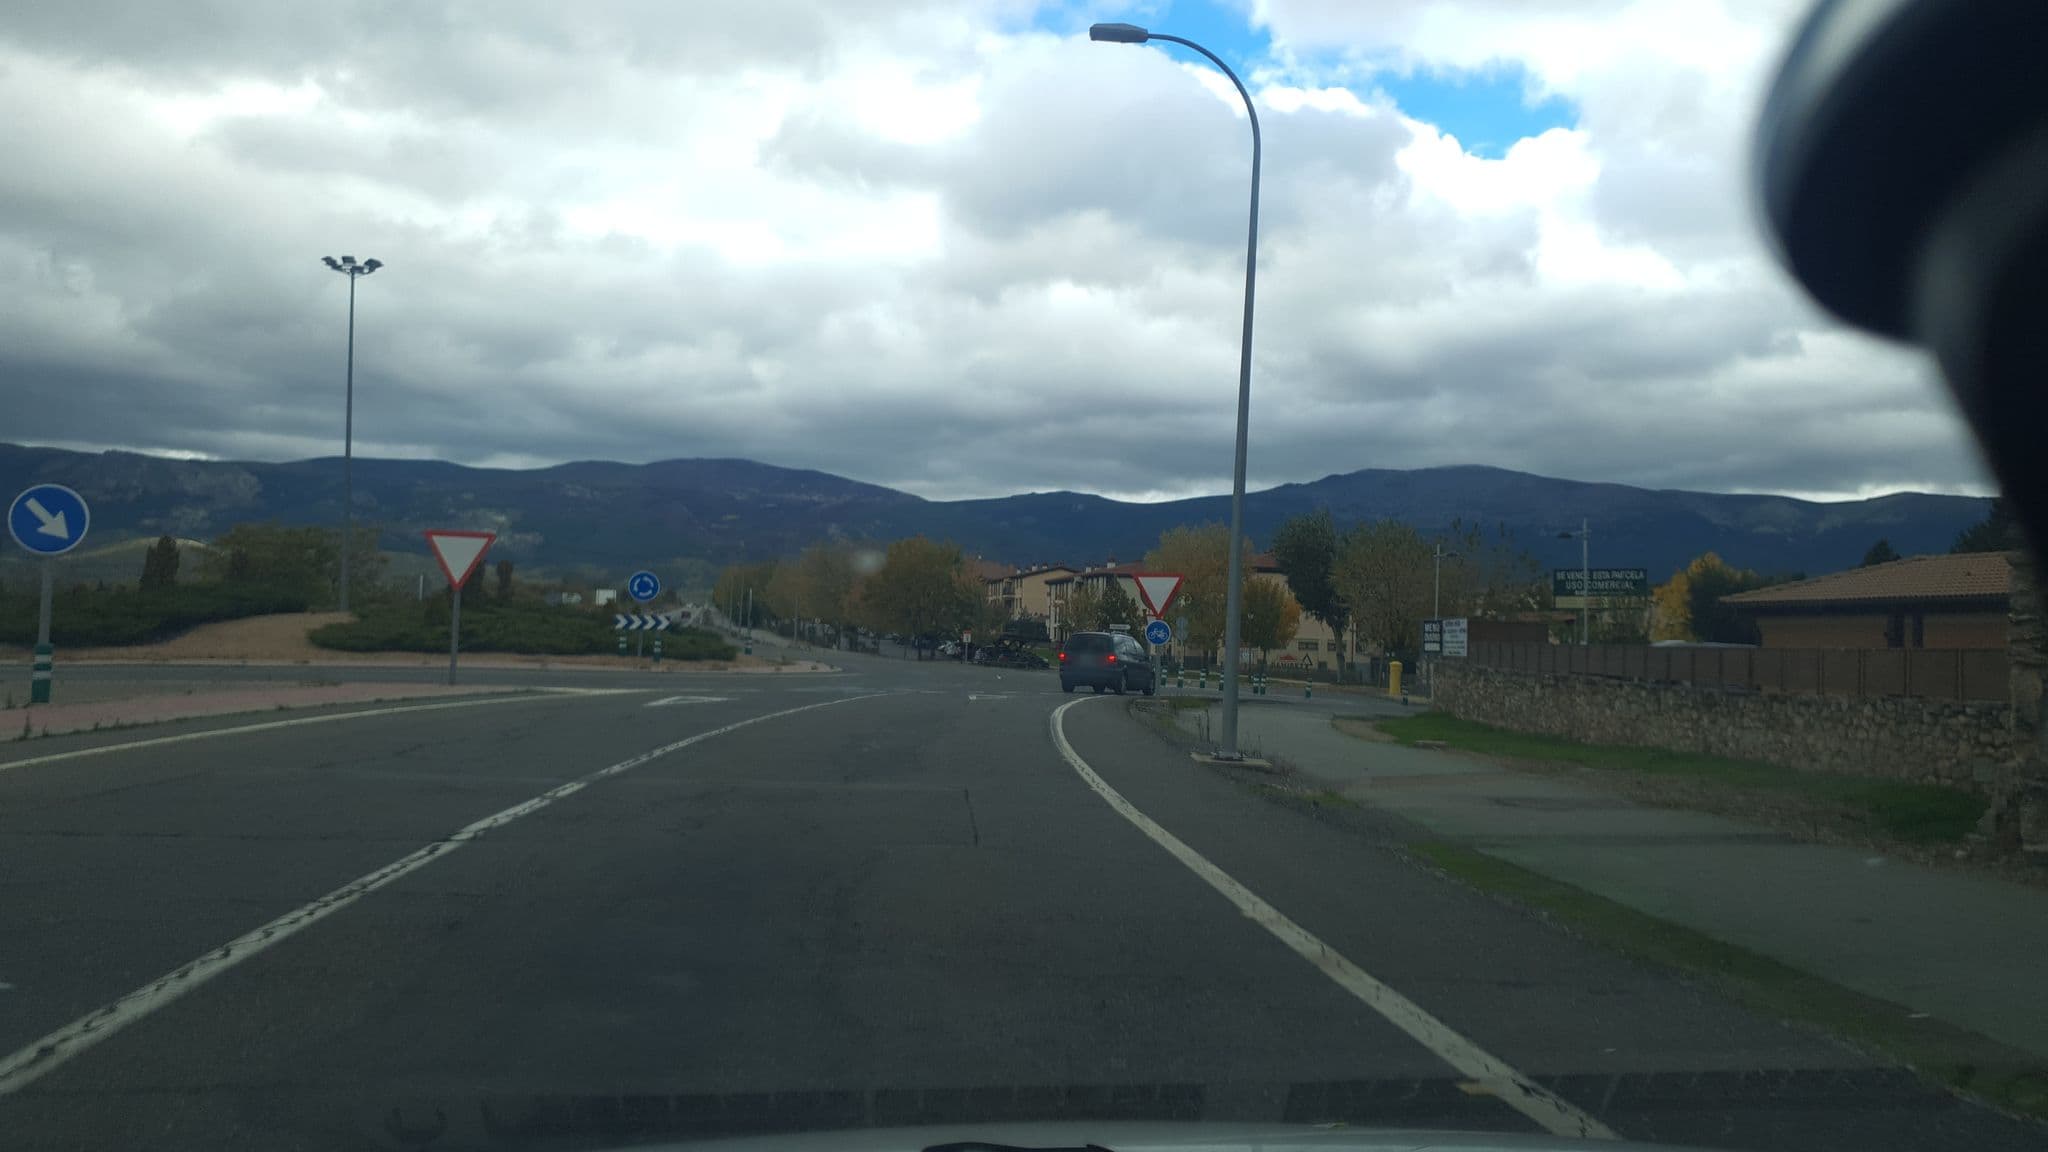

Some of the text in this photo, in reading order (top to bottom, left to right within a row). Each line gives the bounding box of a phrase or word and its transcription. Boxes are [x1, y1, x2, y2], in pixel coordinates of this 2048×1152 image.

[1593, 570, 1610, 580] ESTA
[1611, 570, 1645, 580] PARCELA
[1565, 580, 1635, 590] USO COMERCIAL
